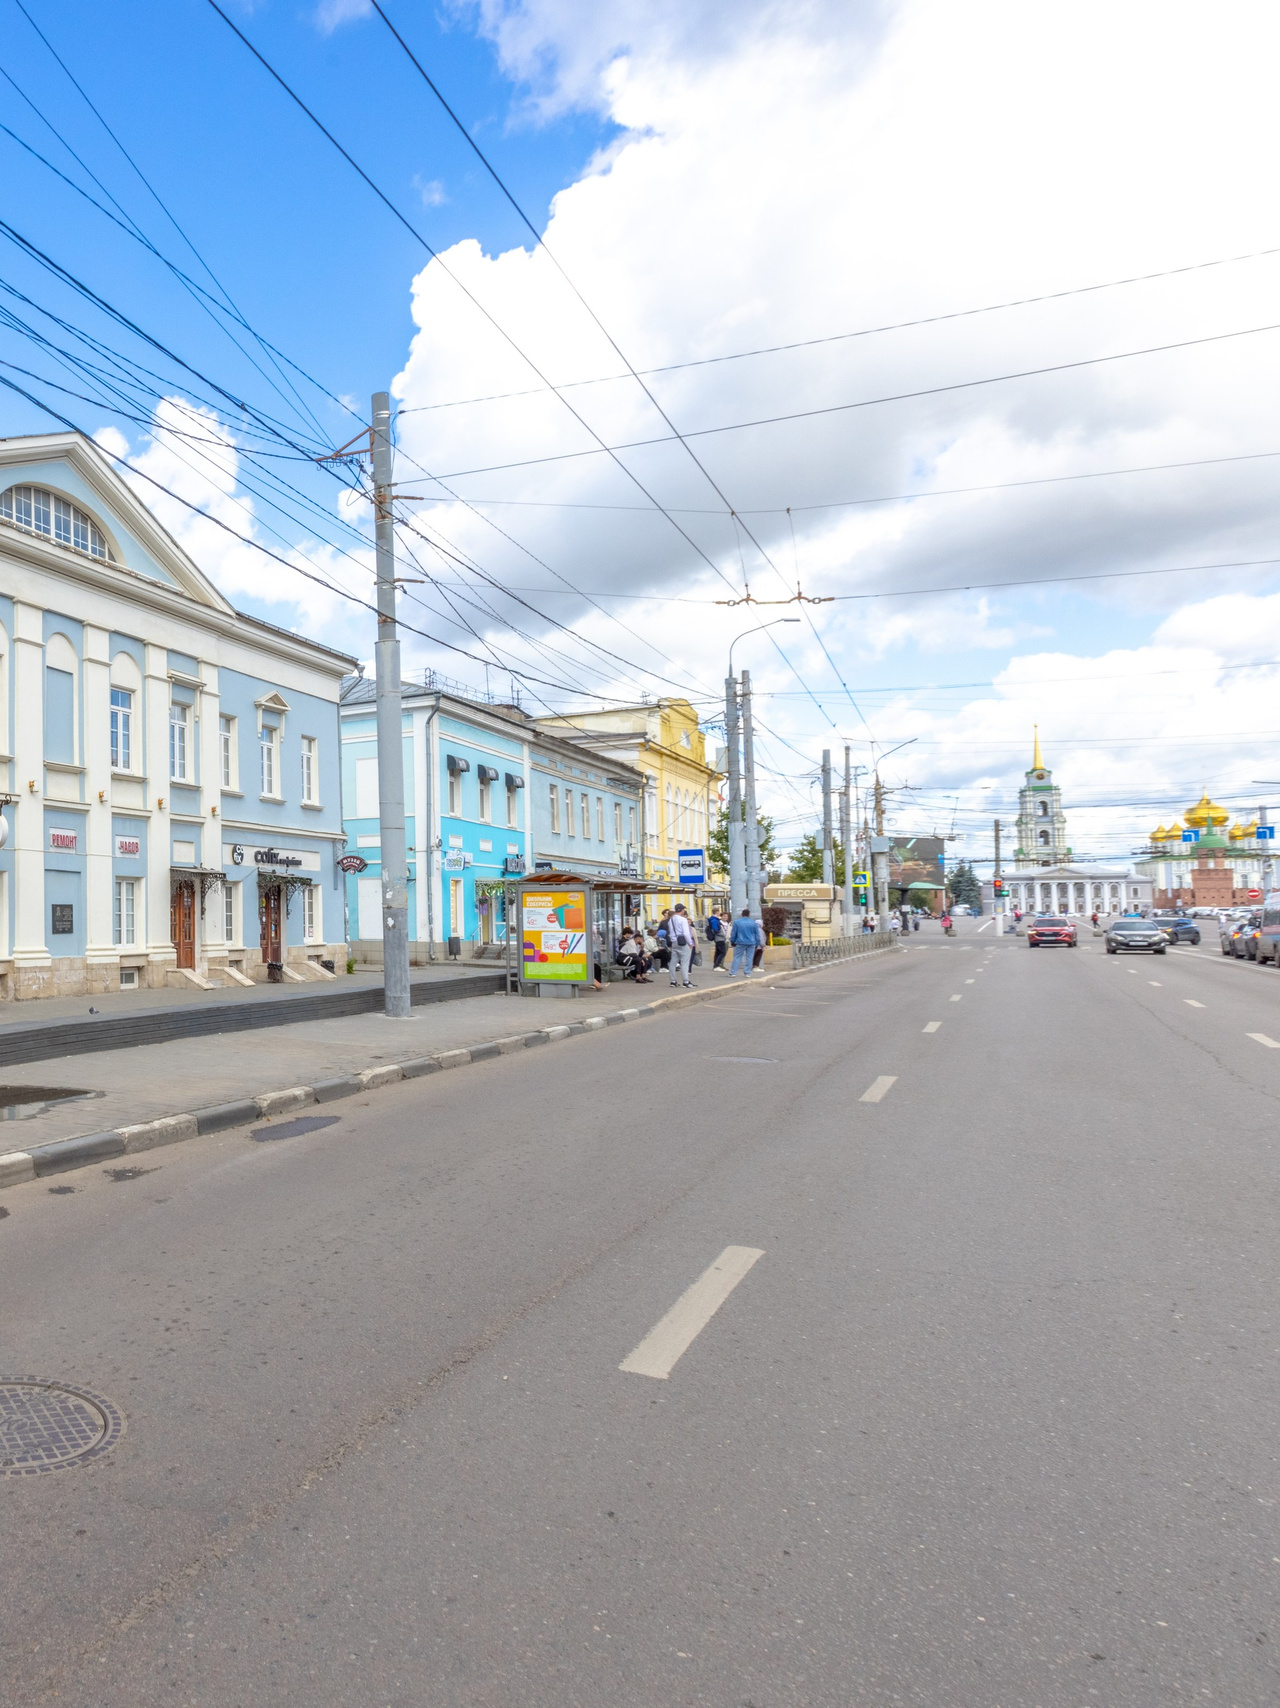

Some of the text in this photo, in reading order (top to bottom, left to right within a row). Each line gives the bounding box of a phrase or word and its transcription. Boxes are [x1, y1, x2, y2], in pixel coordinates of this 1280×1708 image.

[52, 833, 139, 853] РЕМОНТ ЧАСОВ
[254, 848, 279, 865] cofix
[342, 857, 361, 866] МУЗЕЙ
[777, 889, 818, 897] ПРЕССА
